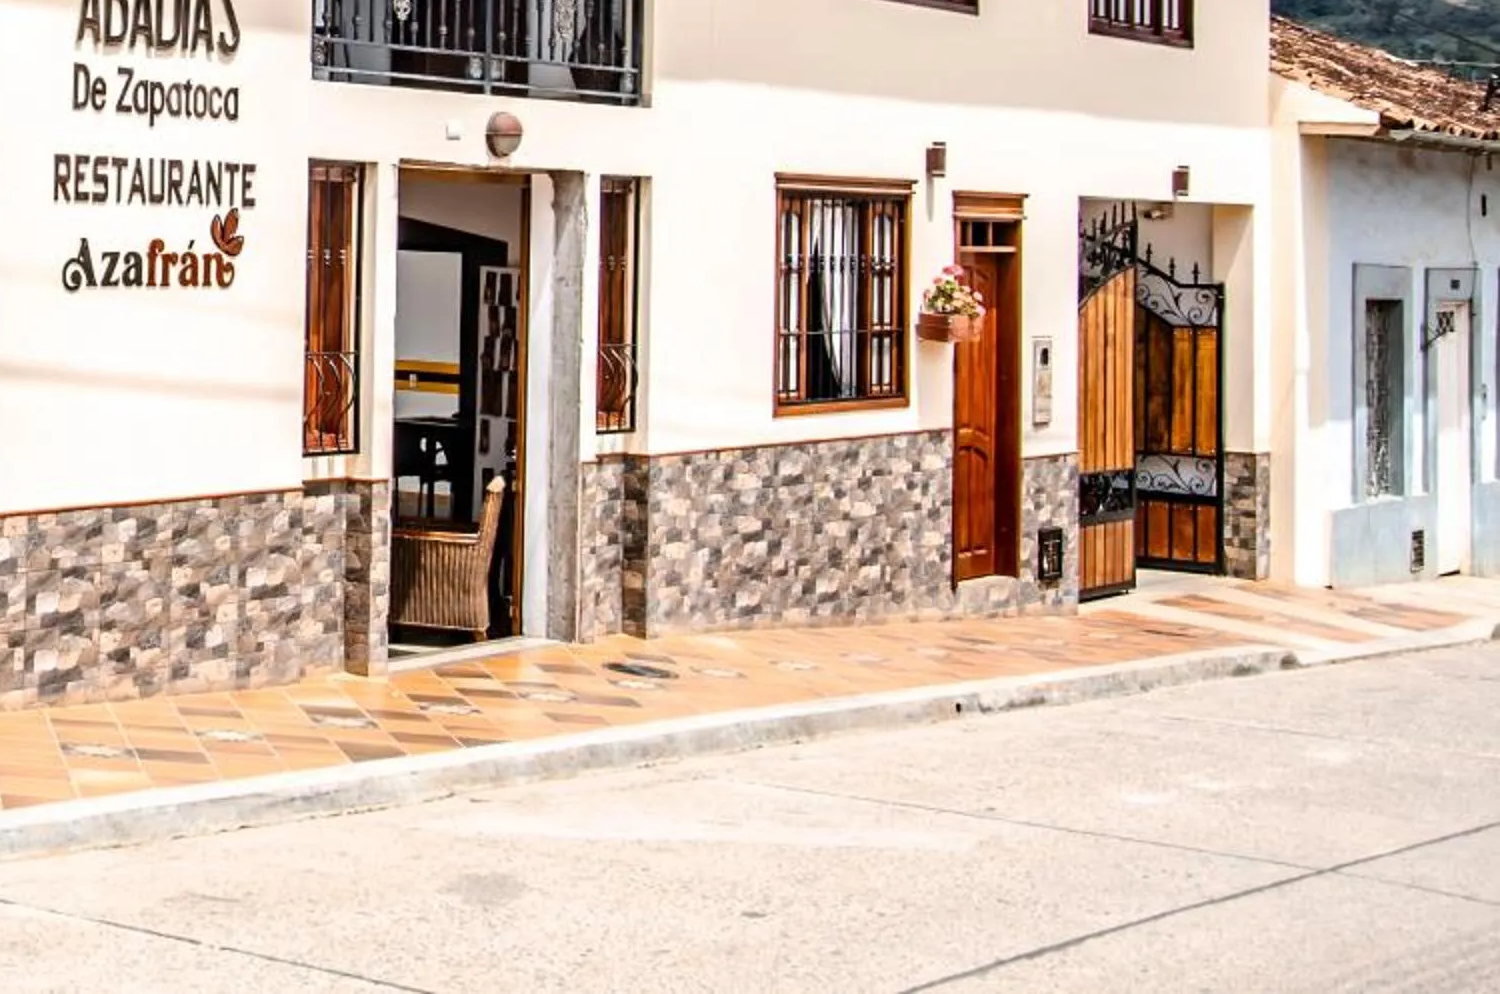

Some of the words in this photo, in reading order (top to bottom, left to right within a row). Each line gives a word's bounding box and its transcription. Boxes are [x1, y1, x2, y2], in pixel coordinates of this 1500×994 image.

[71, 61, 108, 112] De
[115, 66, 241, 128] Zapatoca
[52, 153, 258, 208] RESTAURANTE
[61, 236, 236, 292] Azafrán
